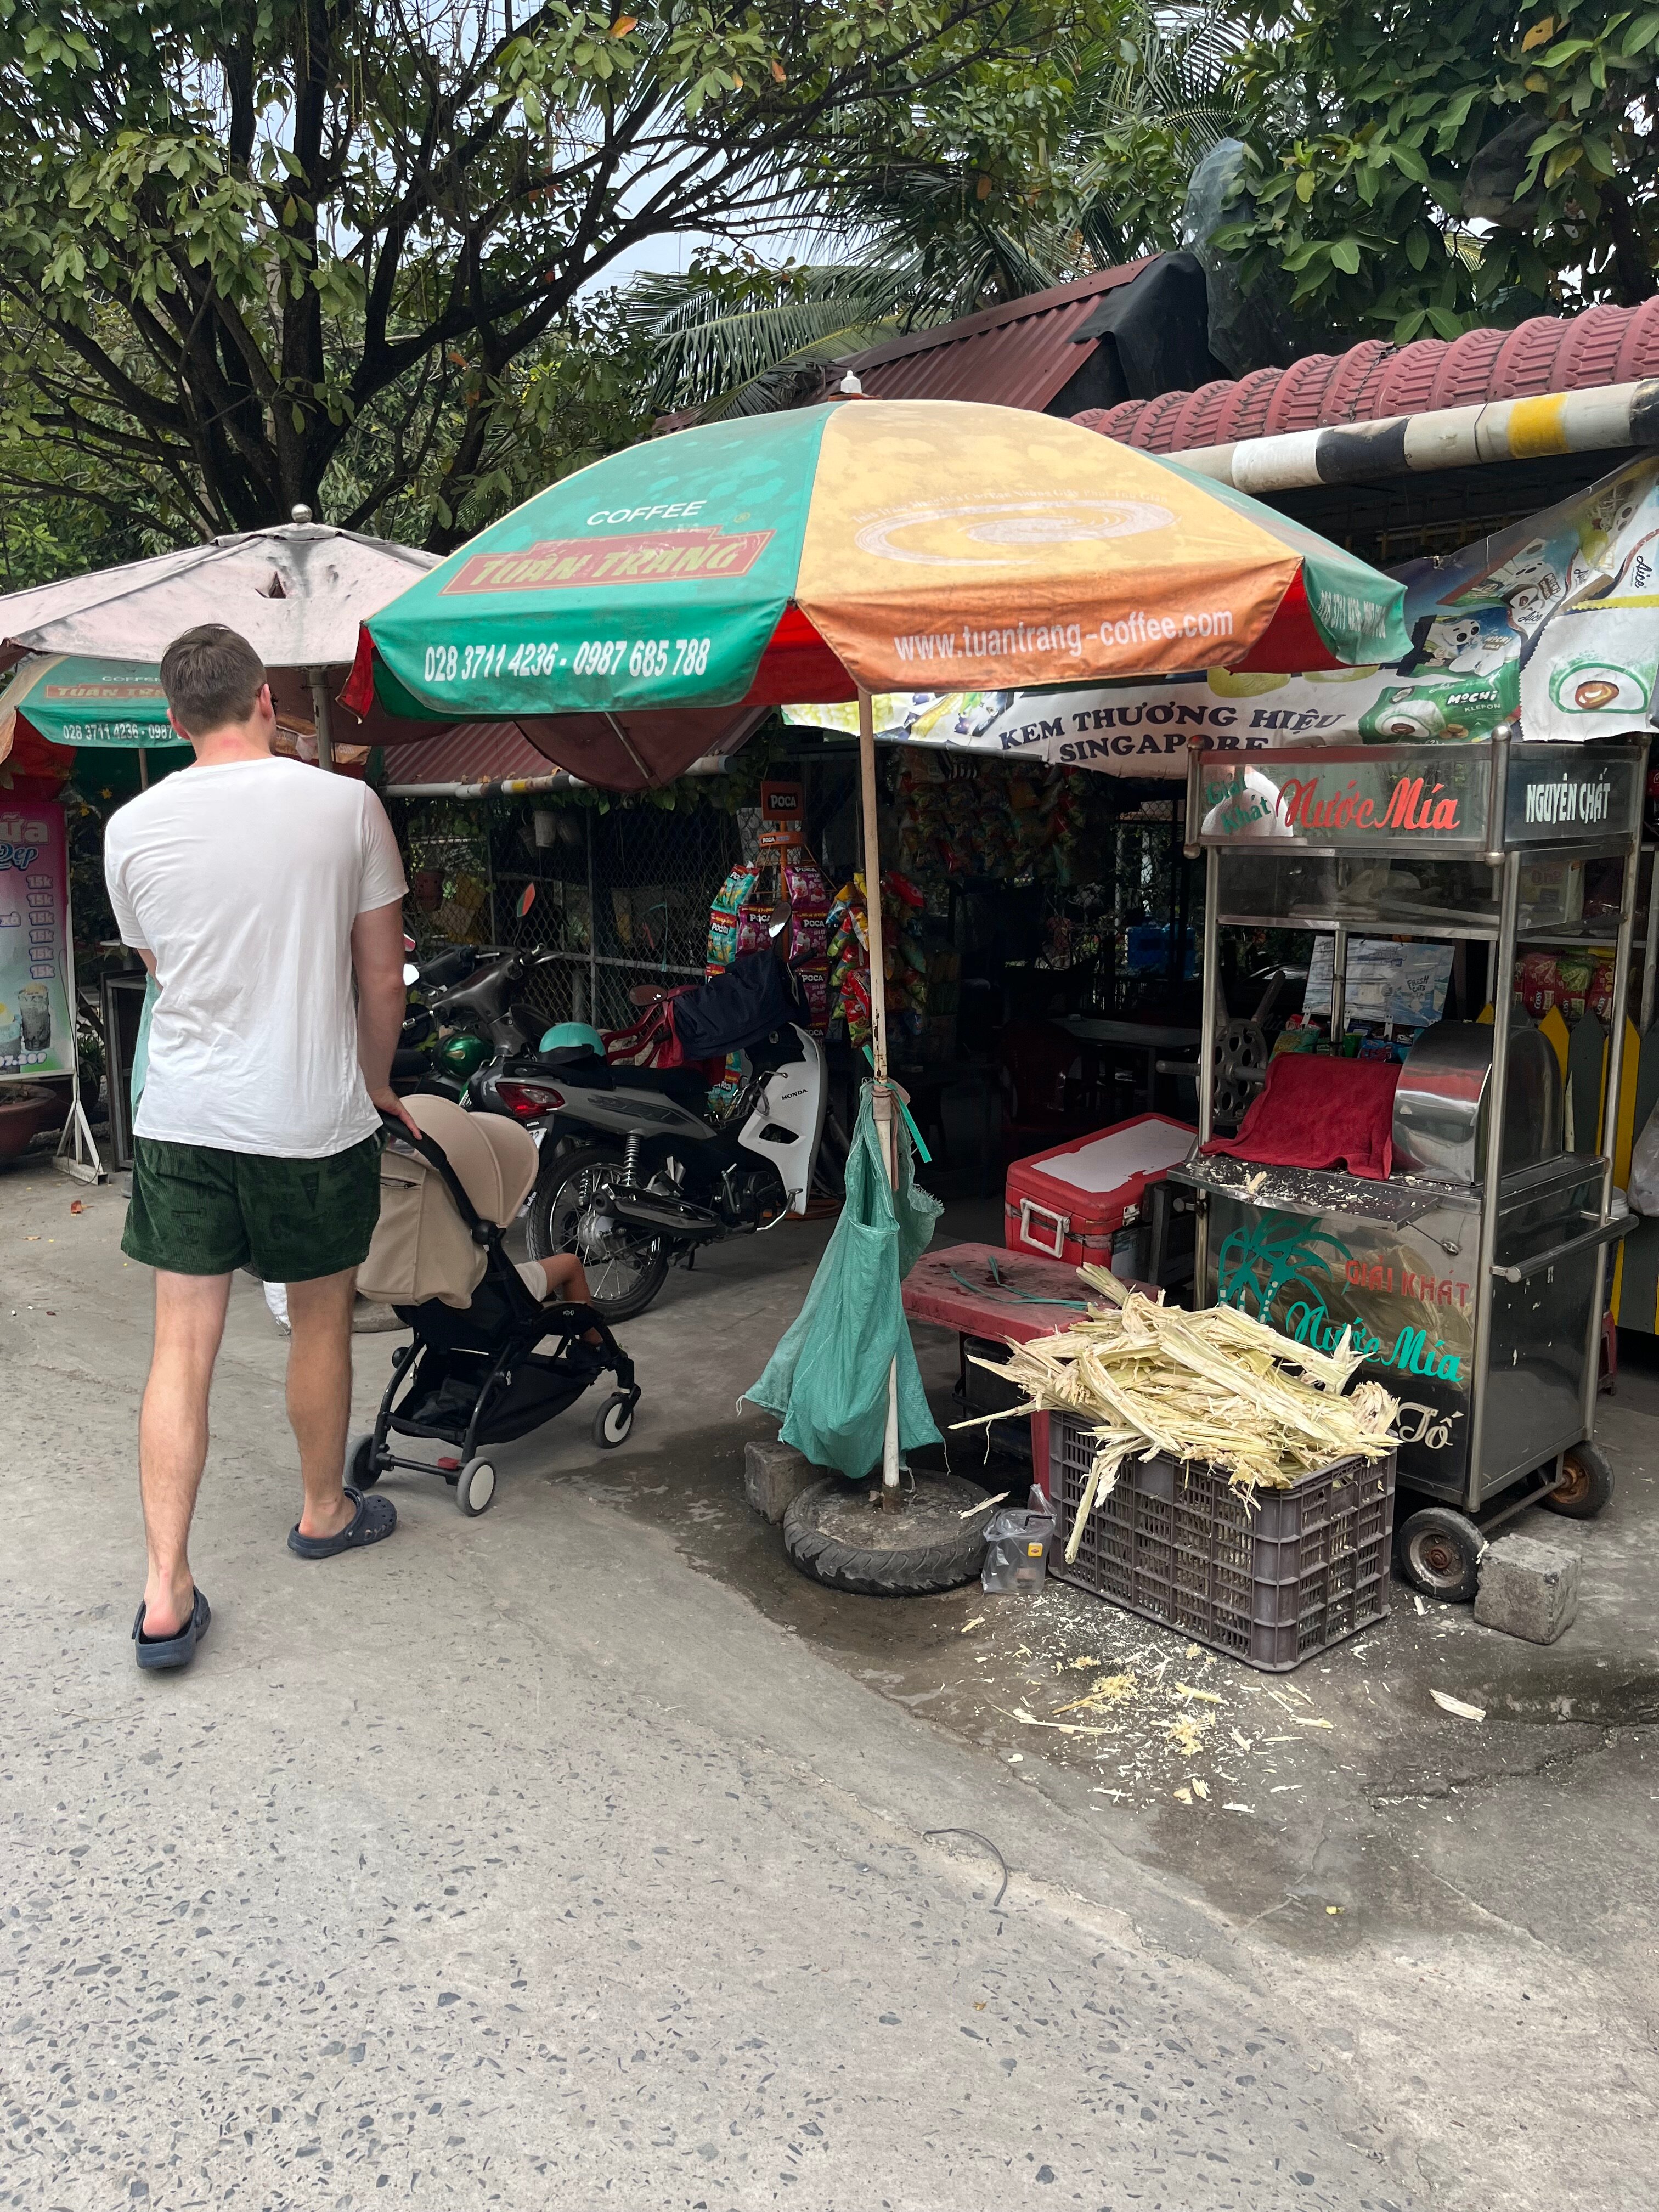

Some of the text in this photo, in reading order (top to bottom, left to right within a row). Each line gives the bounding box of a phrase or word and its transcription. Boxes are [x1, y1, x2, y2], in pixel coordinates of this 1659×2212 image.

[587, 500, 707, 526] COFFEE
[591, 542, 747, 578] TRANG
[424, 645, 458, 681] 028
[461, 644, 506, 679] 3711
[508, 642, 558, 676] 4236
[573, 640, 627, 676] 0987
[629, 639, 669, 677] 685
[672, 638, 711, 676] 788
[999, 701, 1346, 750] KEM THƯƠNG HIỆU
[1465, 703, 1501, 712] KLEPON
[63, 725, 83, 740] 028
[86, 724, 110, 740] 3711
[114, 724, 139, 739] 4236
[148, 725, 172, 739] 0987
[770, 795, 796, 808] POCA
[1207, 770, 1248, 805] Giải
[1276, 777, 1460, 830] Nước Mía
[1526, 768, 1610, 824] NGUYÊN CHẤT
[1220, 794, 1272, 834] Khát
[803, 919, 825, 928] POCA
[1407, 975, 1430, 990] FRESH
[781, 1088, 808, 1101] HONDA
[1346, 1255, 1470, 1307] GIẢI KHÁT
[1380, 1326, 1464, 1383] Mía
[1396, 1402, 1464, 1449] Tố
